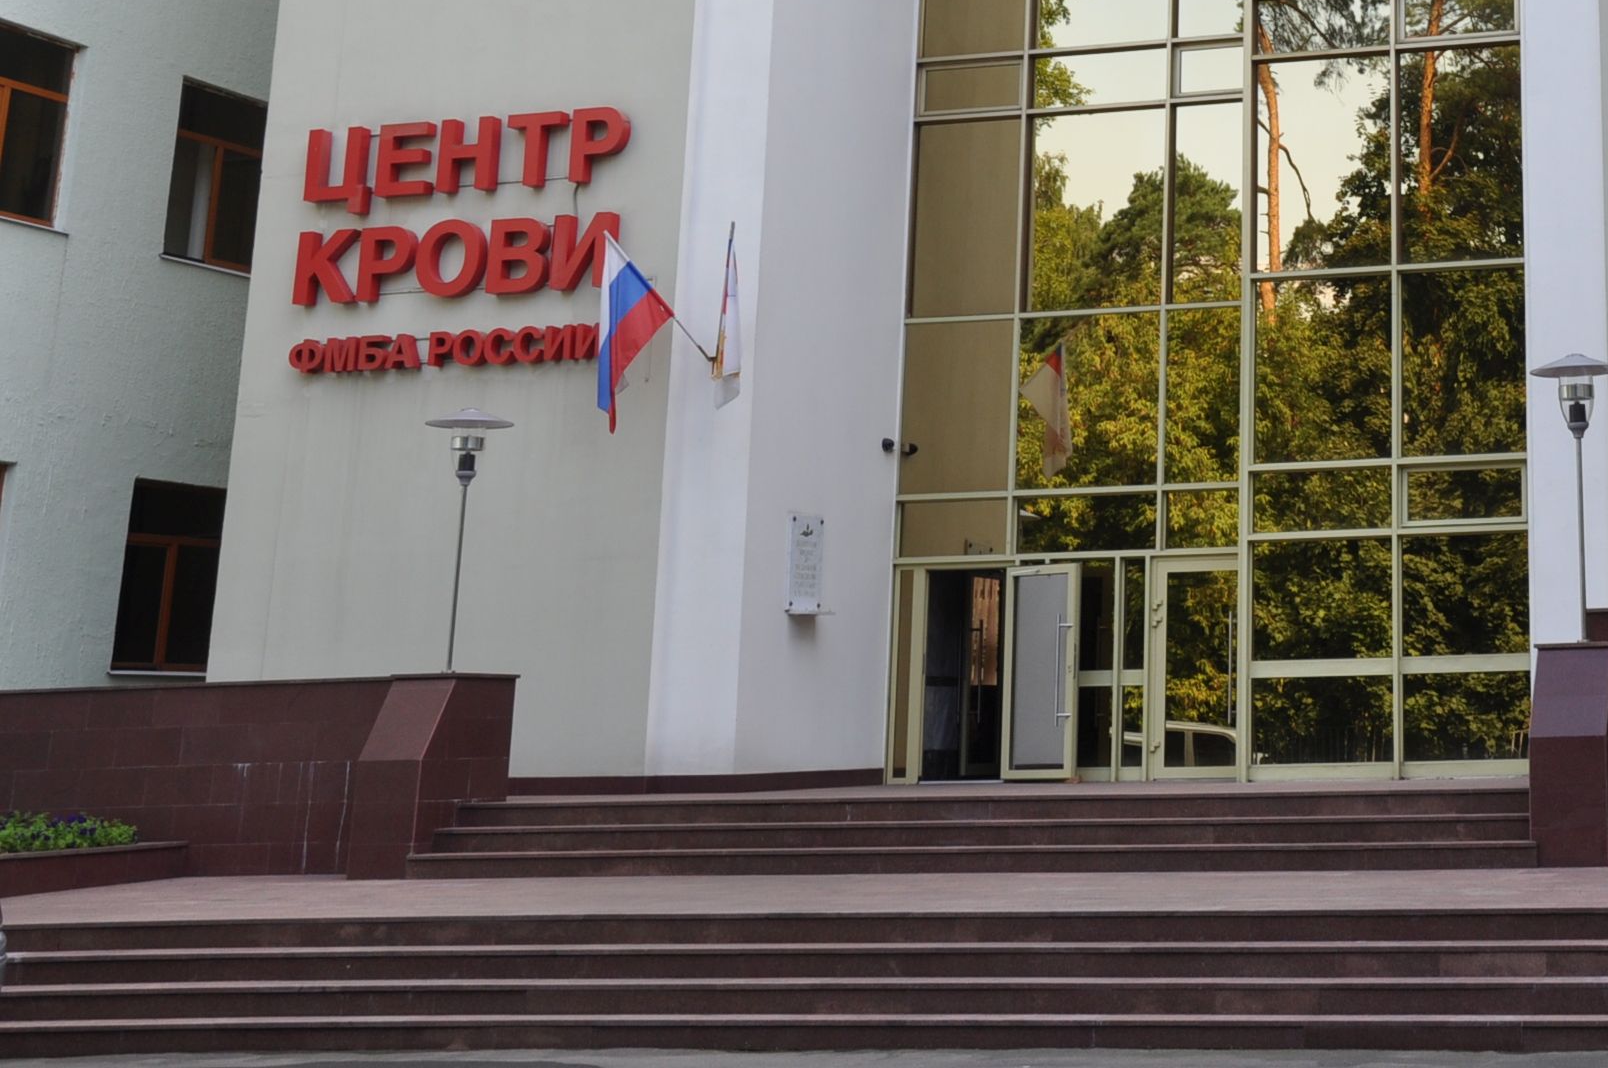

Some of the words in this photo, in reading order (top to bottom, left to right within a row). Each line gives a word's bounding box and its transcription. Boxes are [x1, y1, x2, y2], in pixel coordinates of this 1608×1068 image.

[303, 106, 632, 215] ЦЕНТР
[292, 211, 621, 307] КРОВИ
[288, 333, 422, 375] ФМБА
[428, 322, 600, 368] РОССИИ
